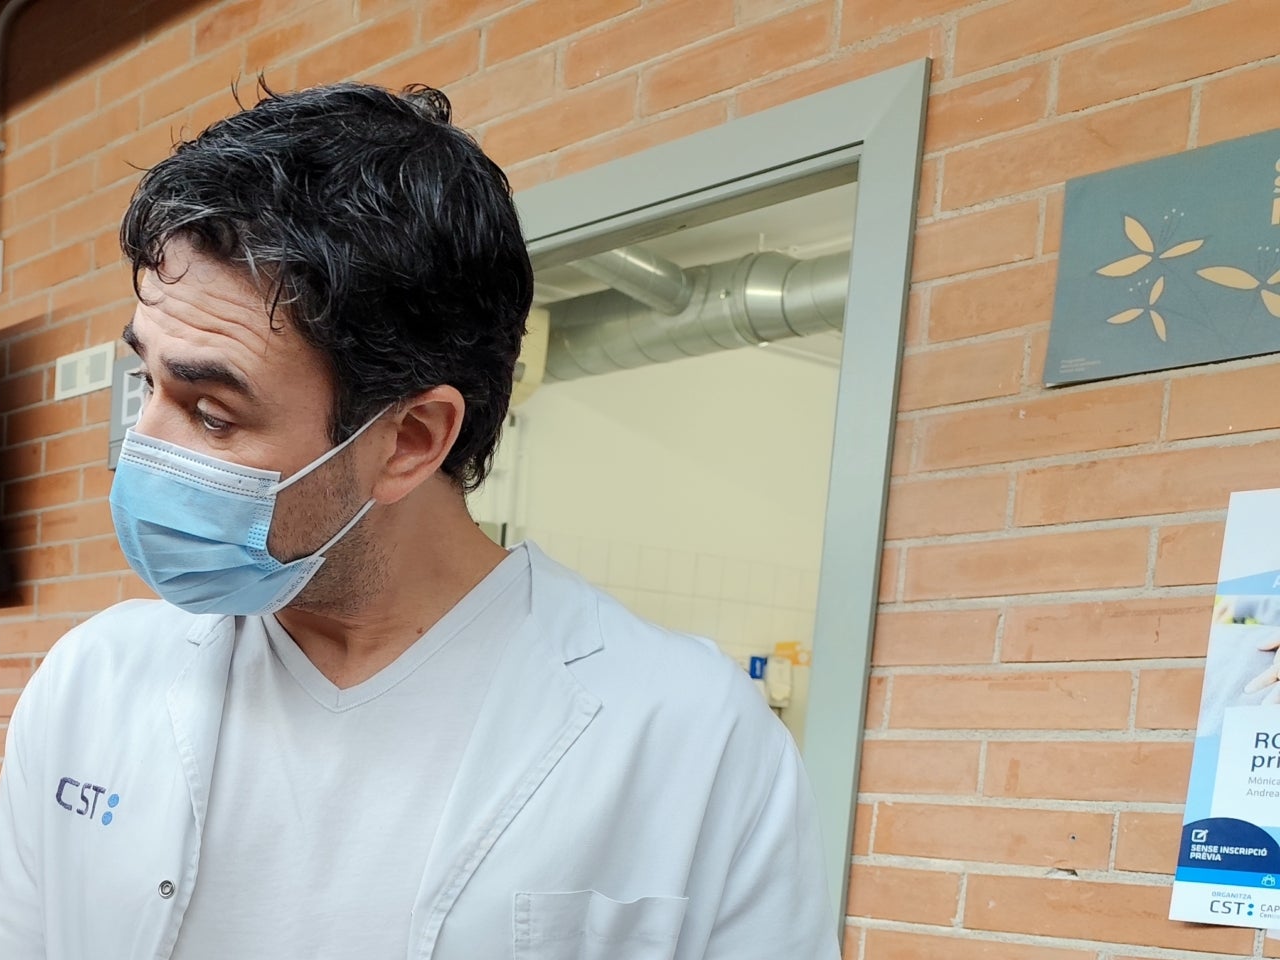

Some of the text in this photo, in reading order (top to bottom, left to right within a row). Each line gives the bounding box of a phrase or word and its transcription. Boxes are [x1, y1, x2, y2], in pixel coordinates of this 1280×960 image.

[1246, 788, 1280, 798] Andrea
[1190, 844, 1268, 857] SENSE INSCRIPCIÓ
[1211, 890, 1252, 900] ORGANITZA
[1260, 903, 1280, 913] CAP
